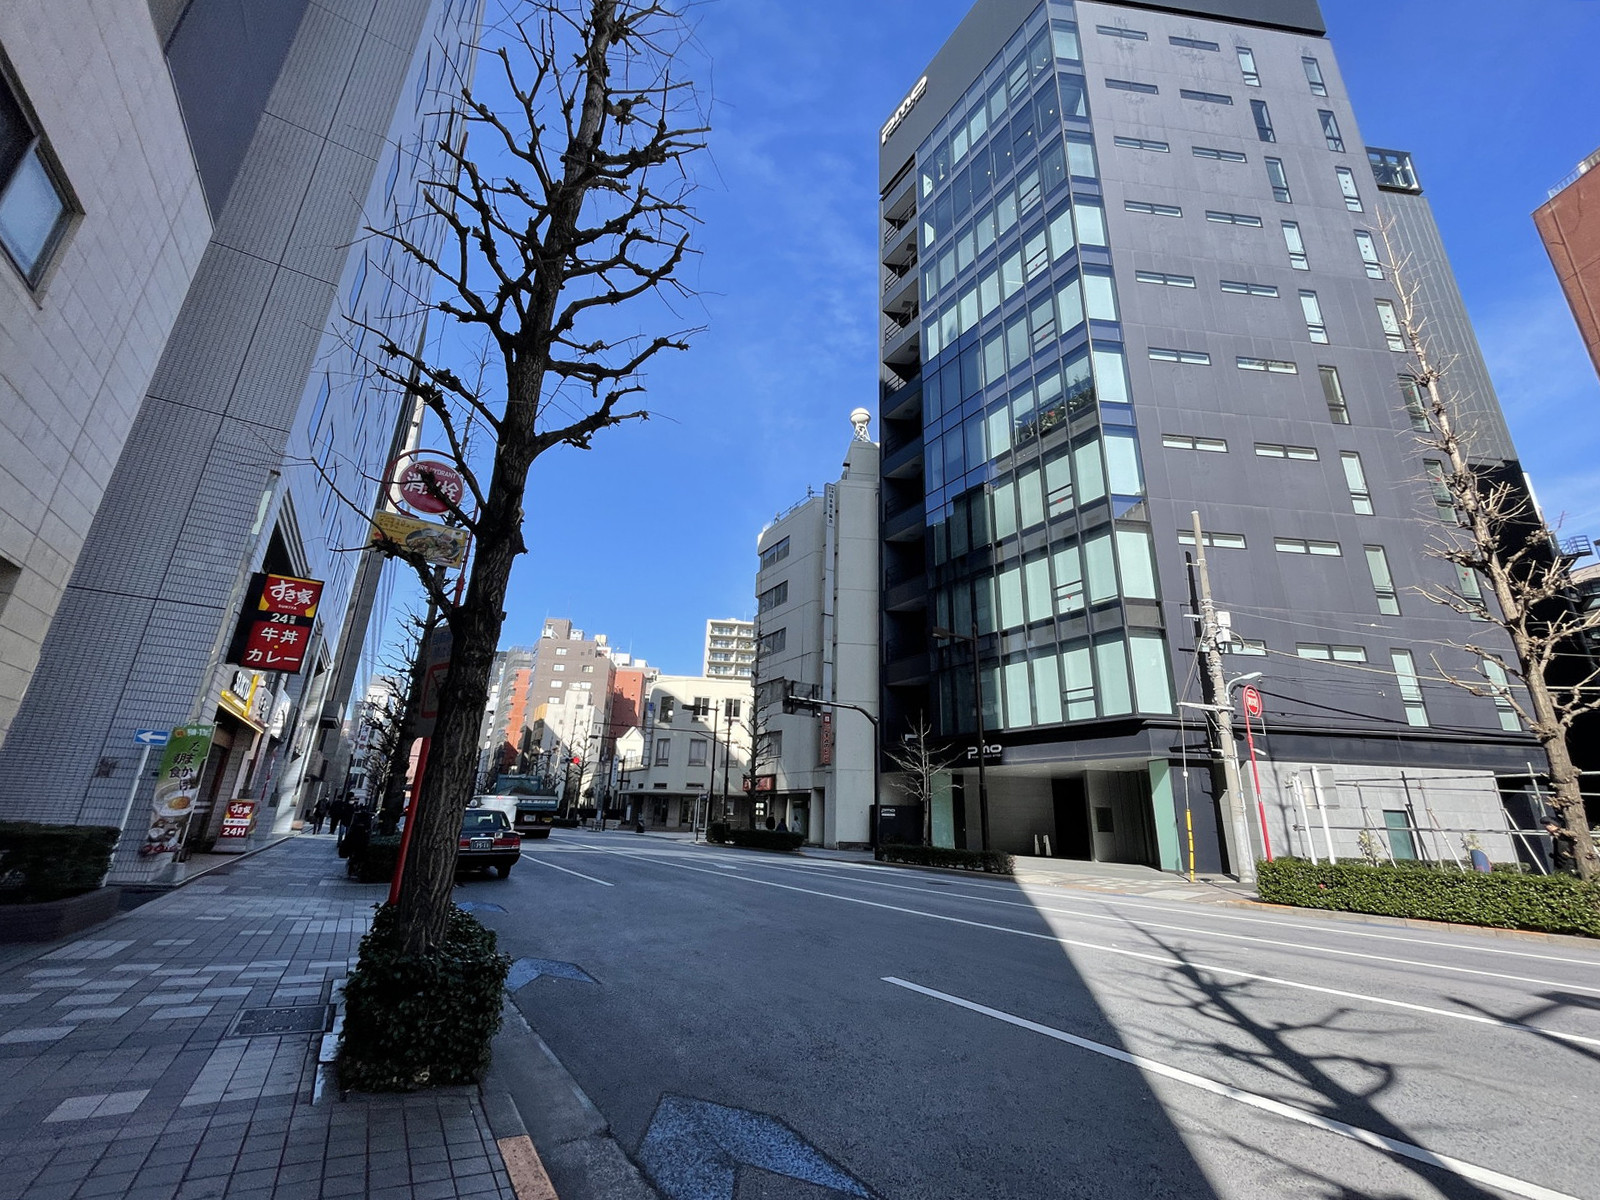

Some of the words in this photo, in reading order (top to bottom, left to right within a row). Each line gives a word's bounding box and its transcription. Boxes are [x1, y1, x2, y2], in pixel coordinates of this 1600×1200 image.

[414, 463, 428, 473] FIRE
[403, 471, 459, 502] 消栓
[269, 580, 314, 605] すき家
[261, 627, 299, 645] 牛丼
[246, 648, 299, 663] カレー
[168, 753, 187, 779] 朝食
[222, 826, 246, 837] 24H
